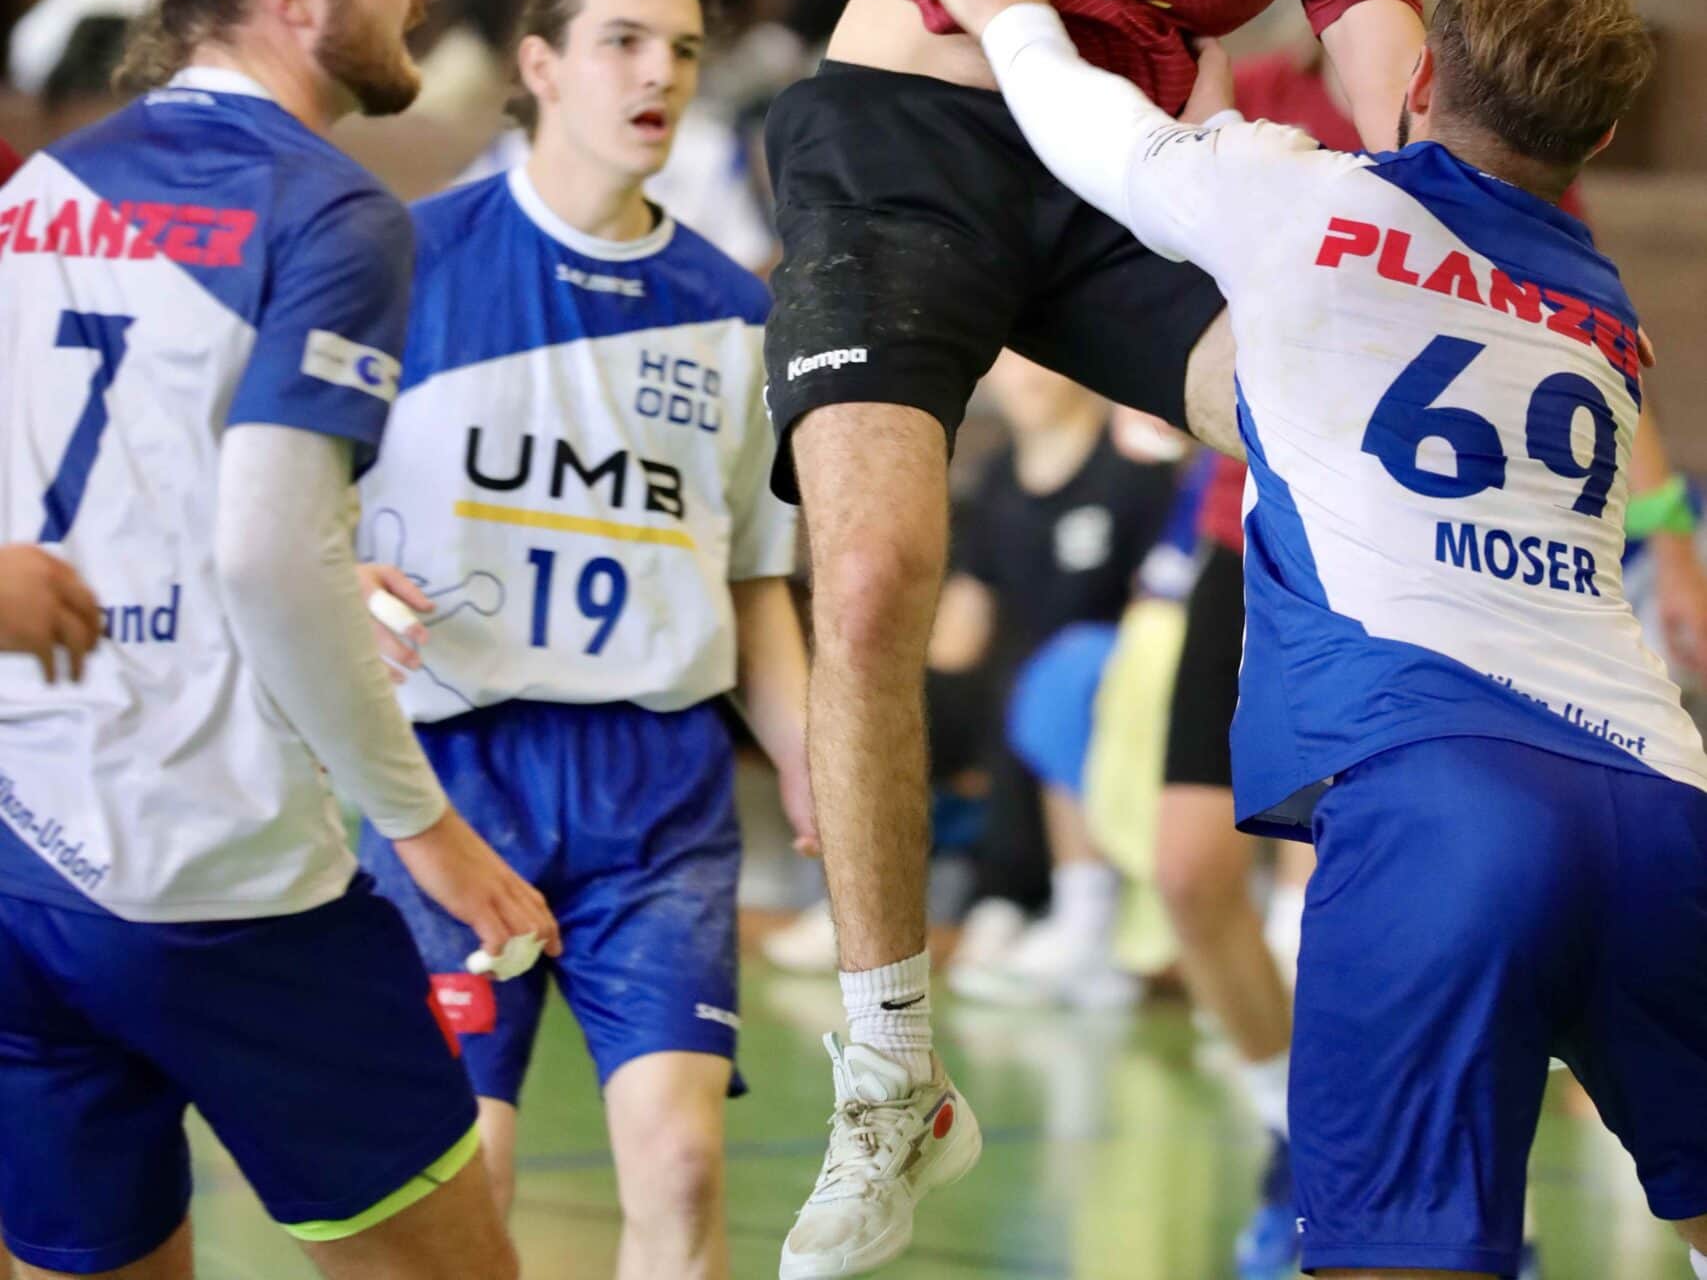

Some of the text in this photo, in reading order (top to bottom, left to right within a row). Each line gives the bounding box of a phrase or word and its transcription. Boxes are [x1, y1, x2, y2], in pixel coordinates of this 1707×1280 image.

[787, 348, 867, 381] Kempa
[40, 310, 137, 543] 7
[464, 426, 686, 520] UMB
[1361, 334, 1618, 519] 69
[525, 547, 629, 656] 19
[1435, 521, 1601, 597] MOSER
